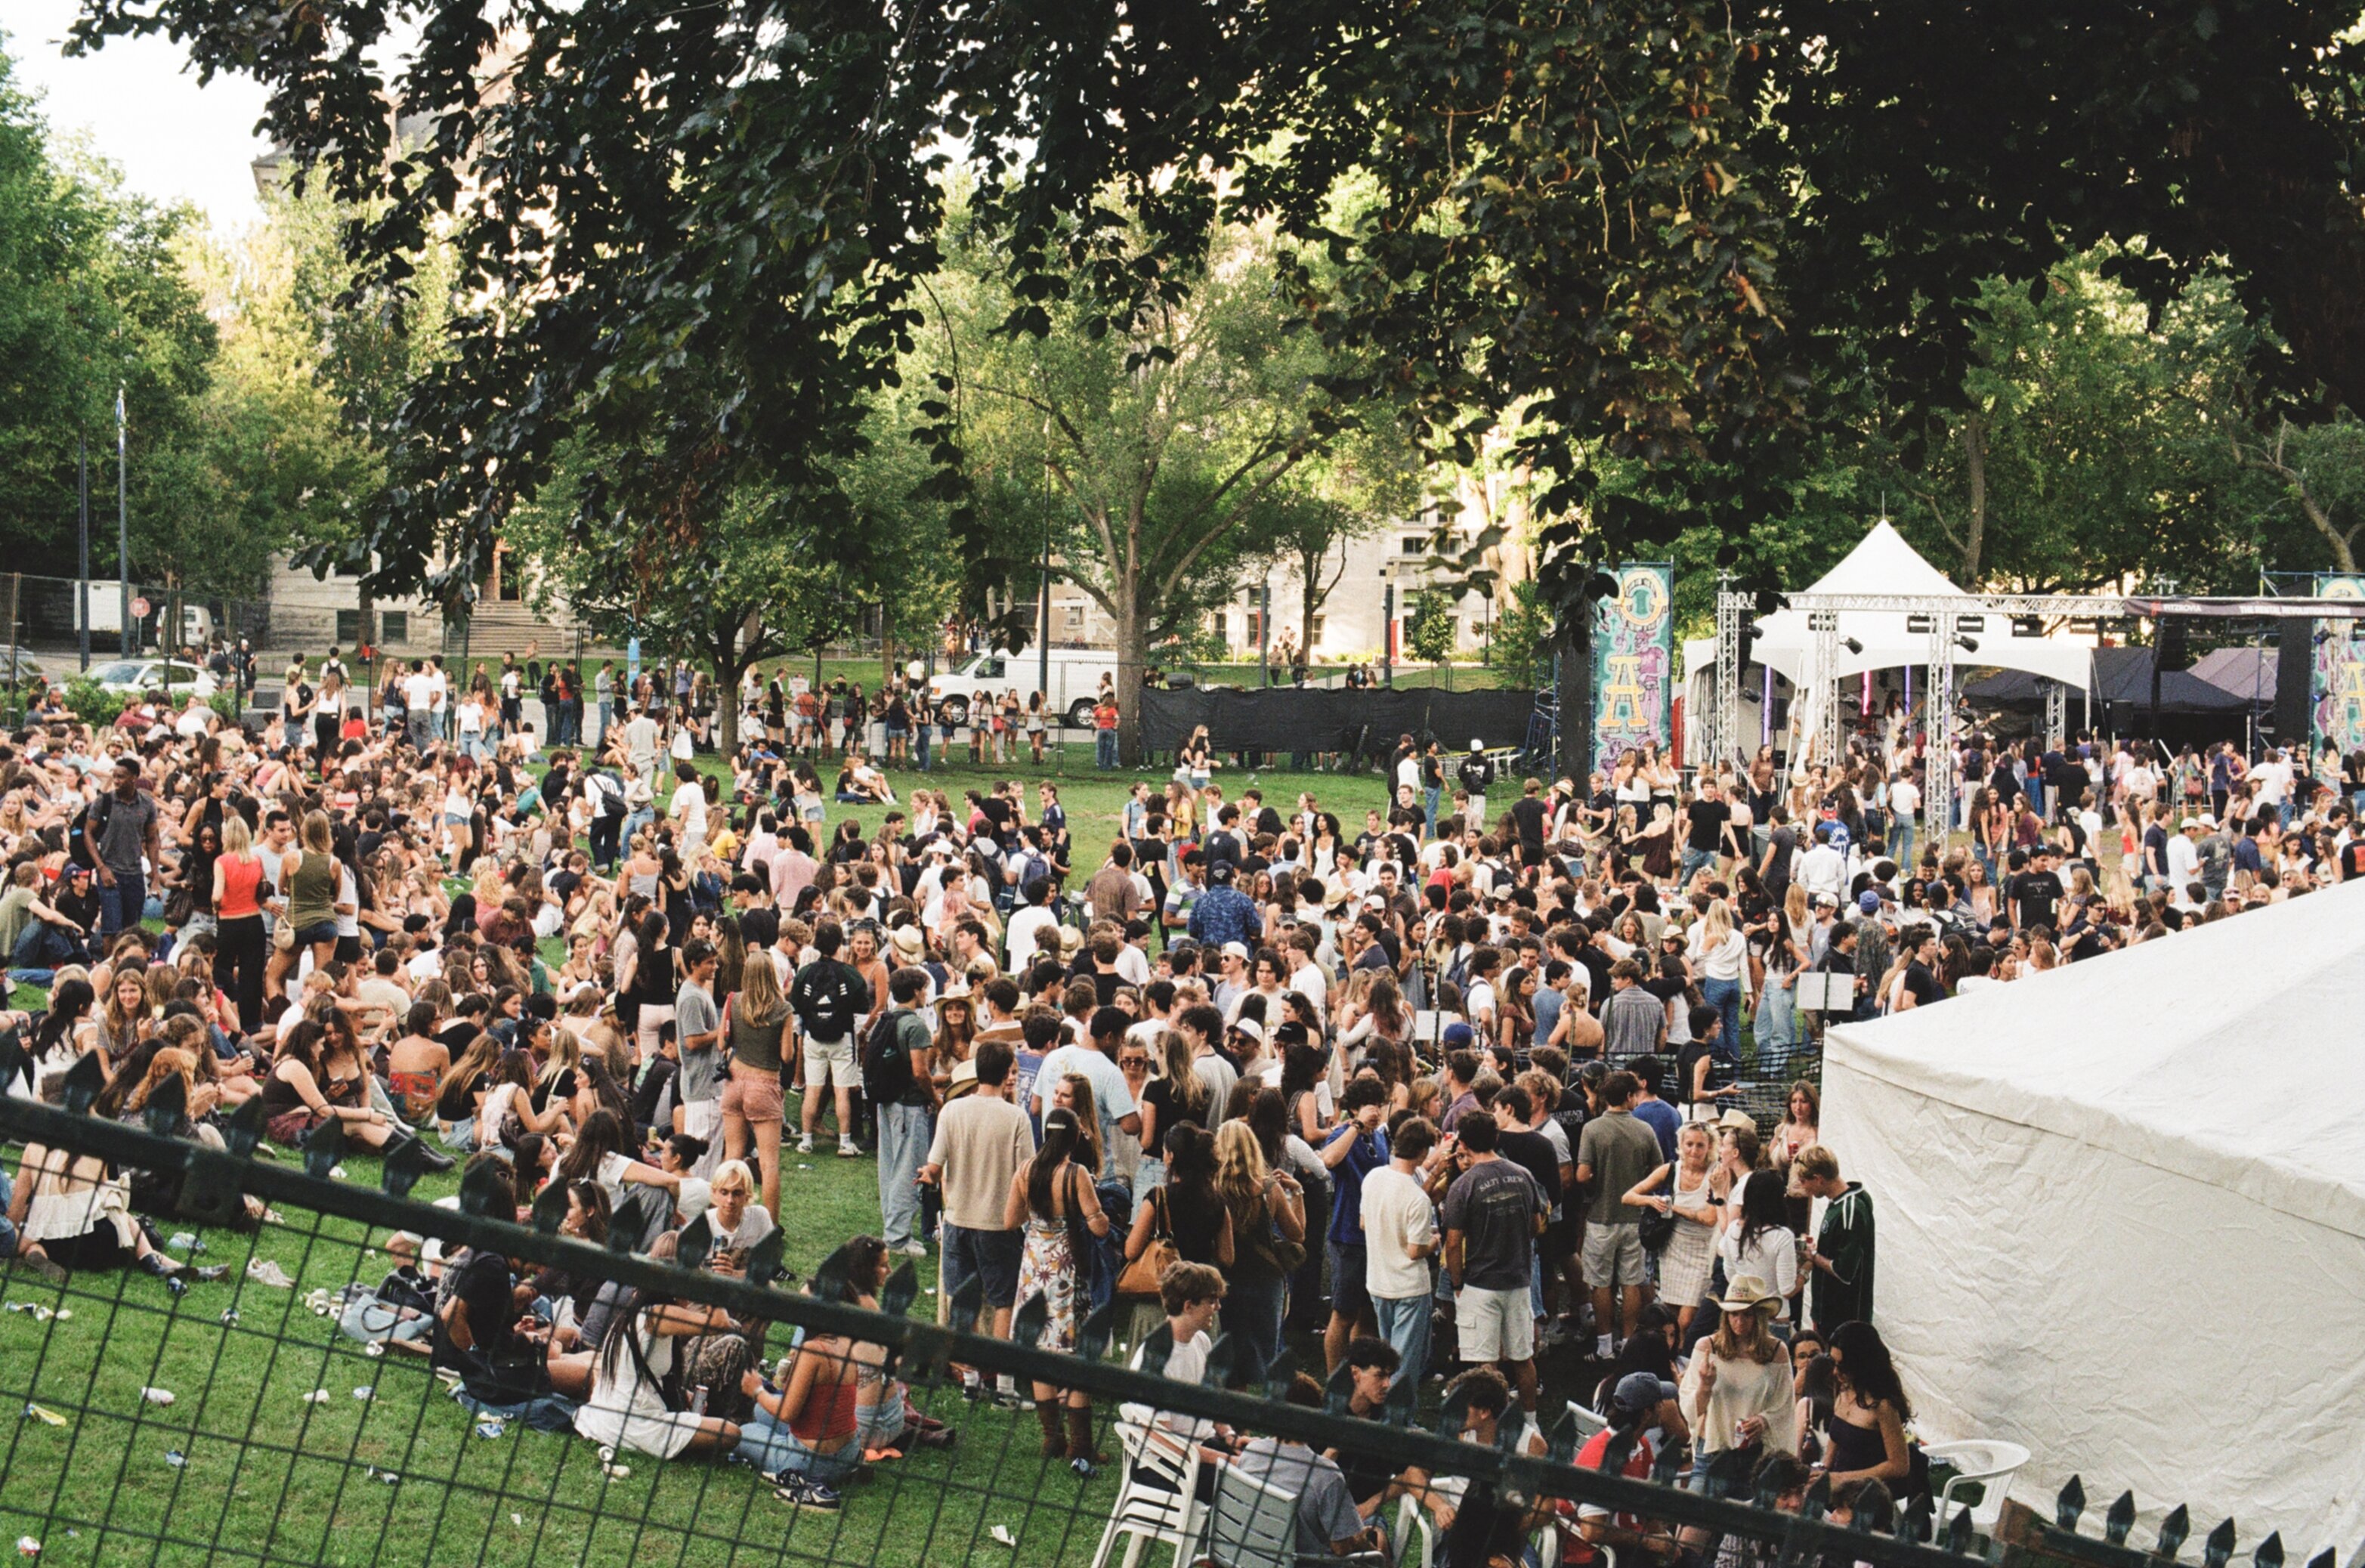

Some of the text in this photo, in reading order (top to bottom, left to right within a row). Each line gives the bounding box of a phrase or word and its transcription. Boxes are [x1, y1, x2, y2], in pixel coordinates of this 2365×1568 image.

[2163, 604, 2202, 612] FITZROVIA
[2239, 605, 2254, 615] THE
[1479, 1177, 1499, 1192] SALTY
